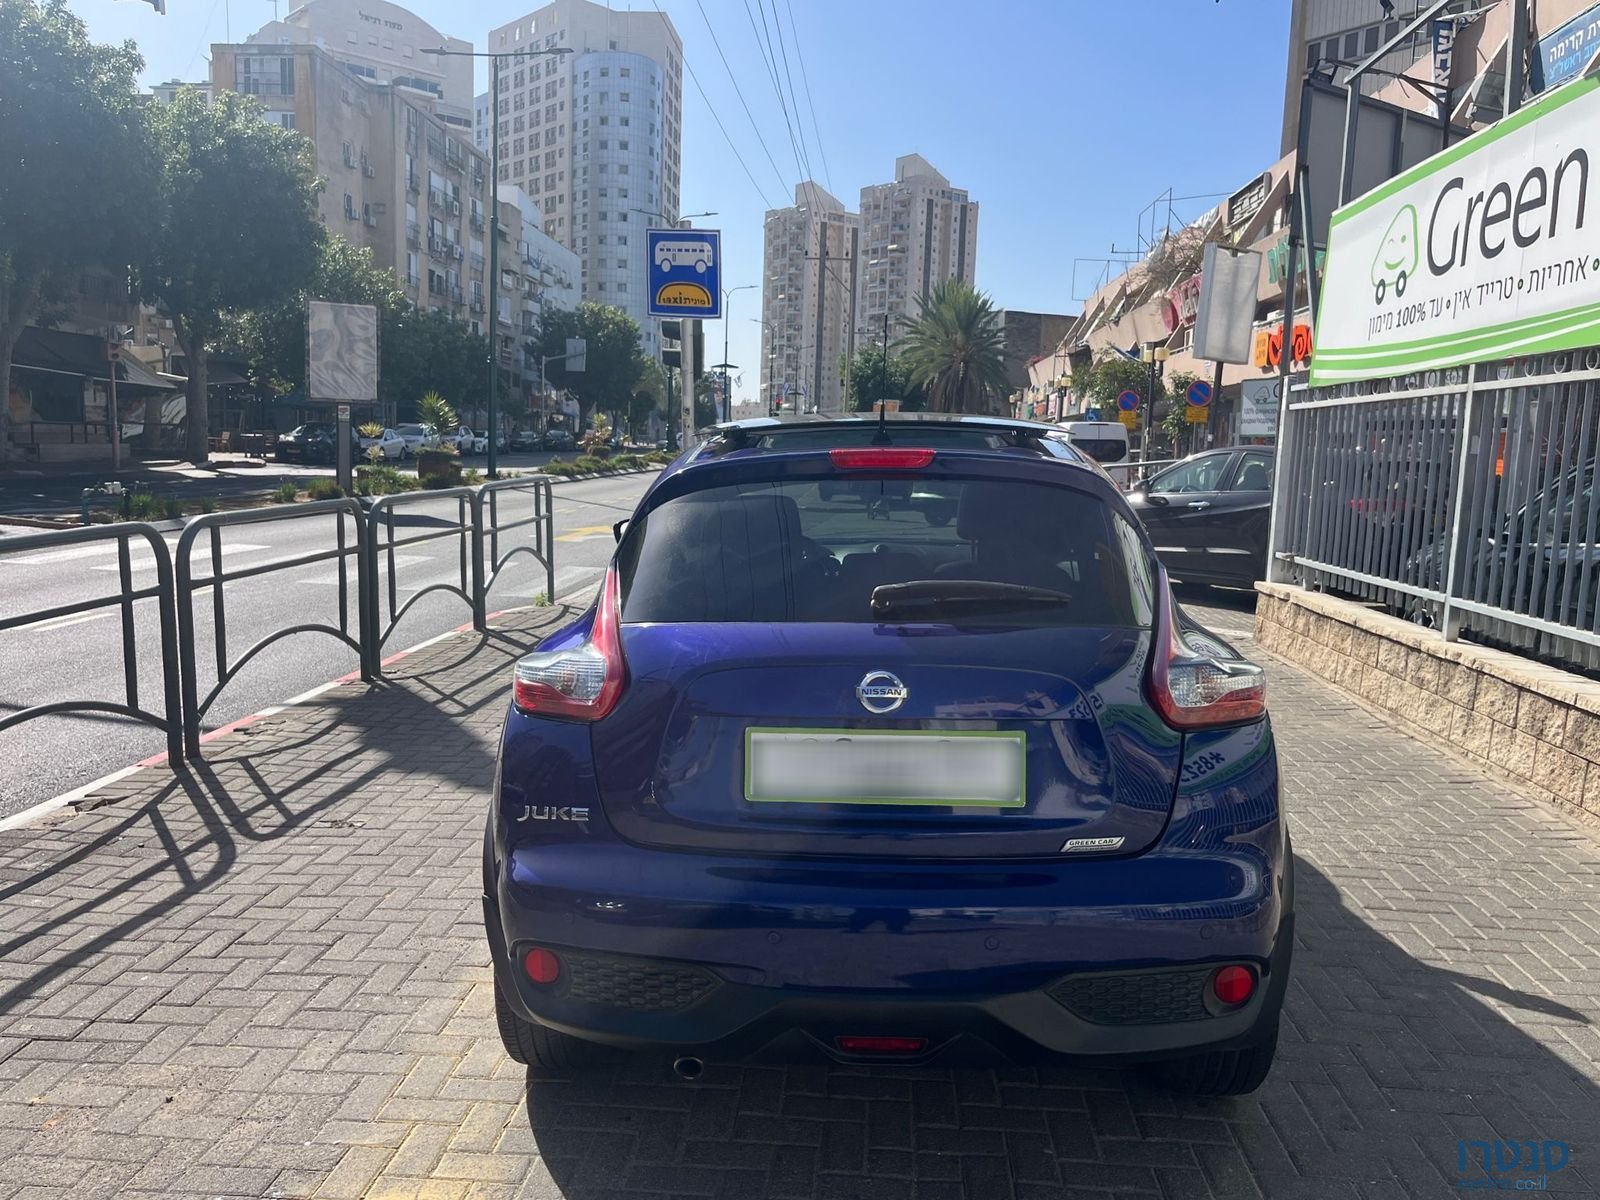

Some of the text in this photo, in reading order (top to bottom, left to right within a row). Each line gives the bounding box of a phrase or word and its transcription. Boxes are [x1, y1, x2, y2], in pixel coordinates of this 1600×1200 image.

[1549, 29, 1585, 64] קדימה
[1426, 147, 1589, 277] Green
[683, 296, 706, 305] מונית
[1367, 254, 1589, 341] אחריות טרייד אין עד 100% מימון
[861, 688, 902, 696] NISSAN
[516, 805, 590, 822] JUKE
